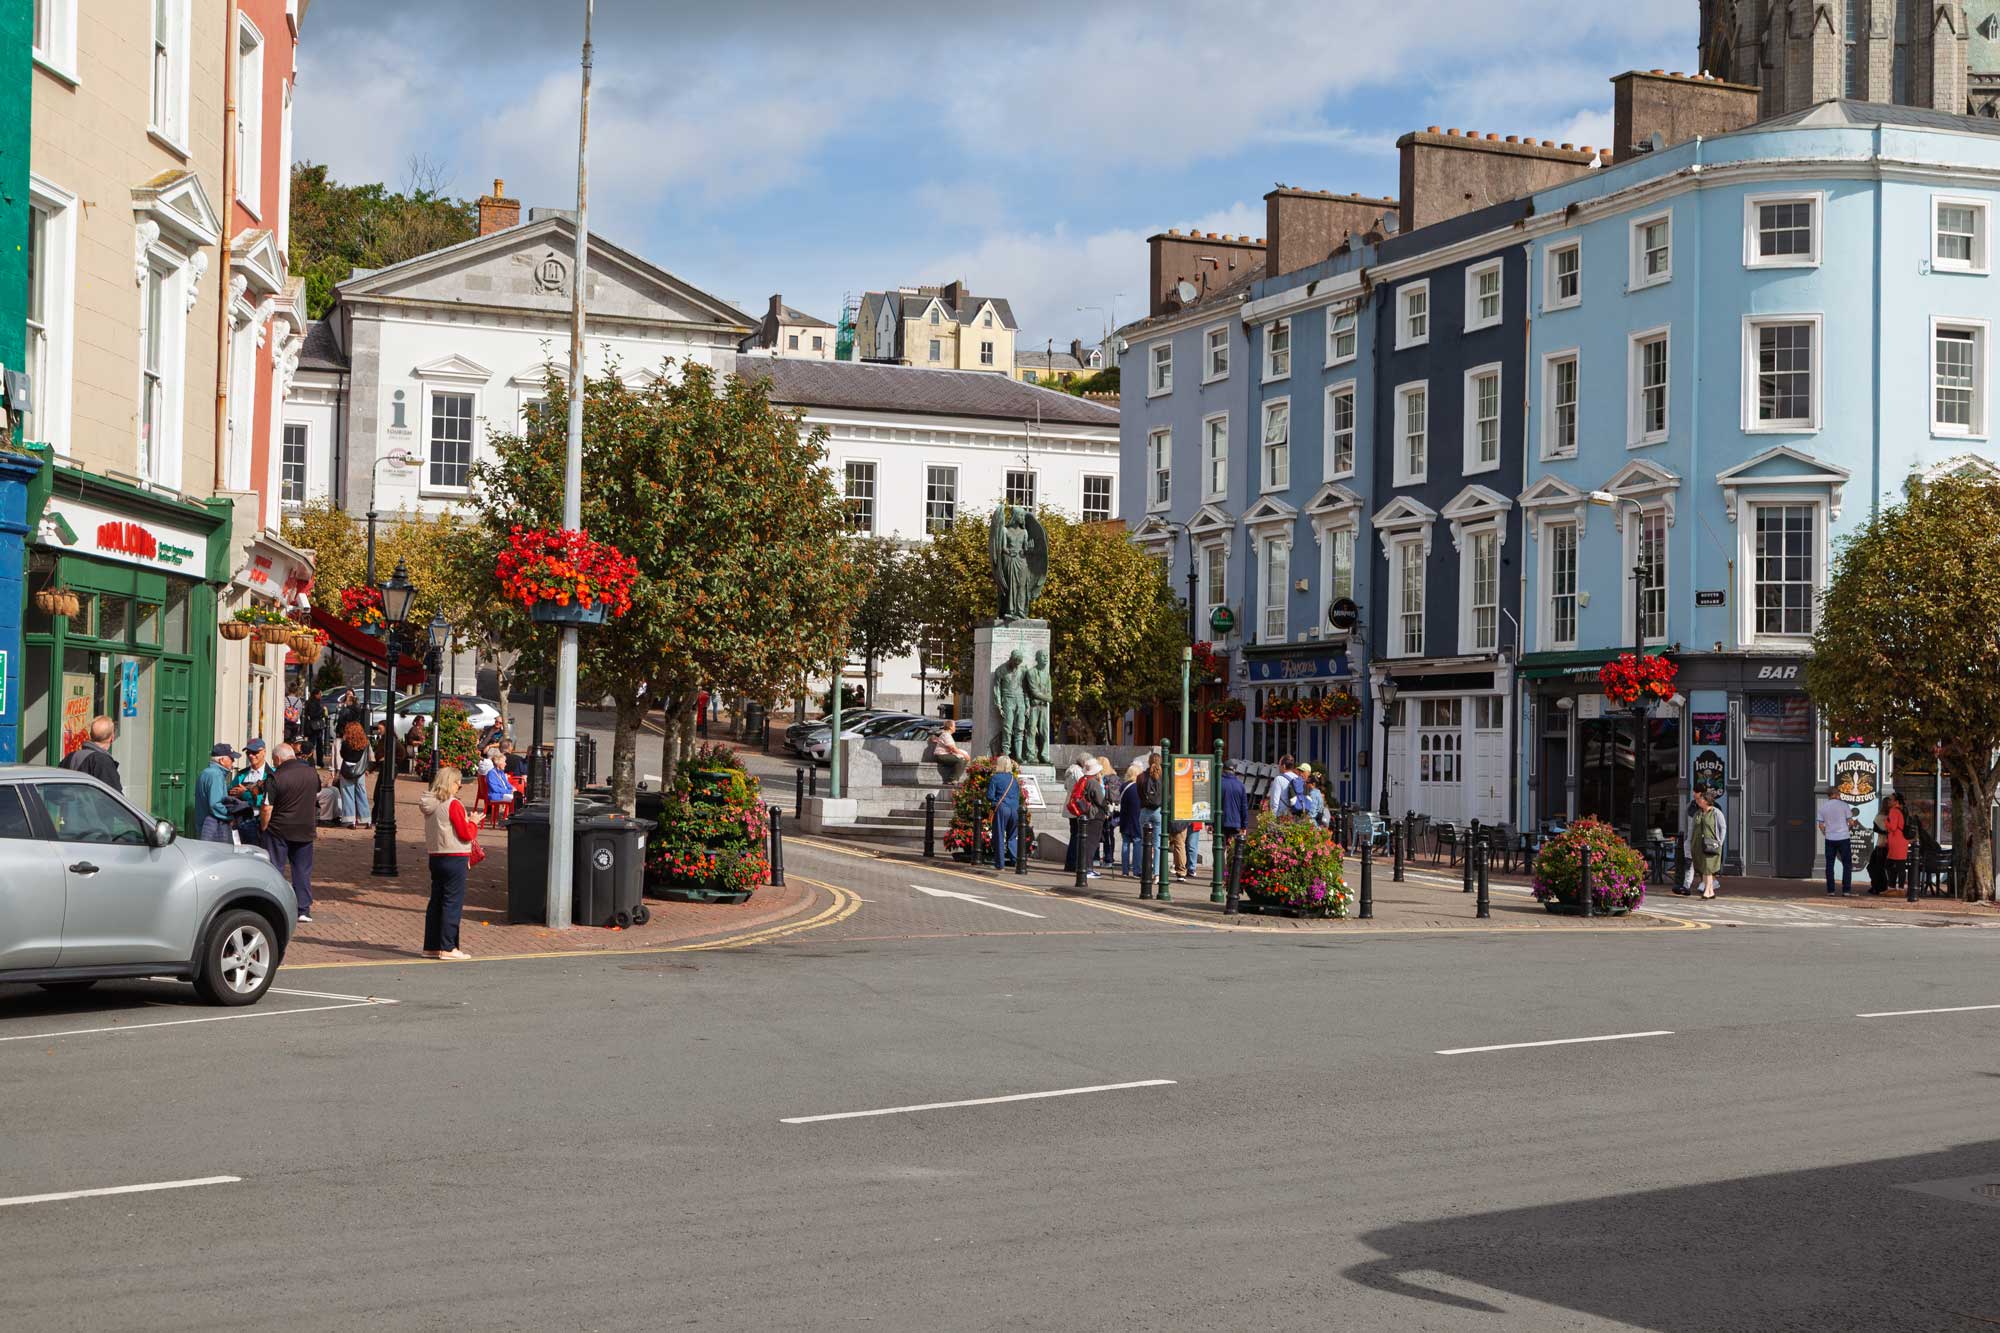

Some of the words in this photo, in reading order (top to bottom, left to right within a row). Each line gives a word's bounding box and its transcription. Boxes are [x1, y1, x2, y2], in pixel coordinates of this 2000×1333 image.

[1758, 666, 1798, 679] BAR
[1695, 761, 1723, 772] Irish
[1857, 791, 1876, 802] STOUT
